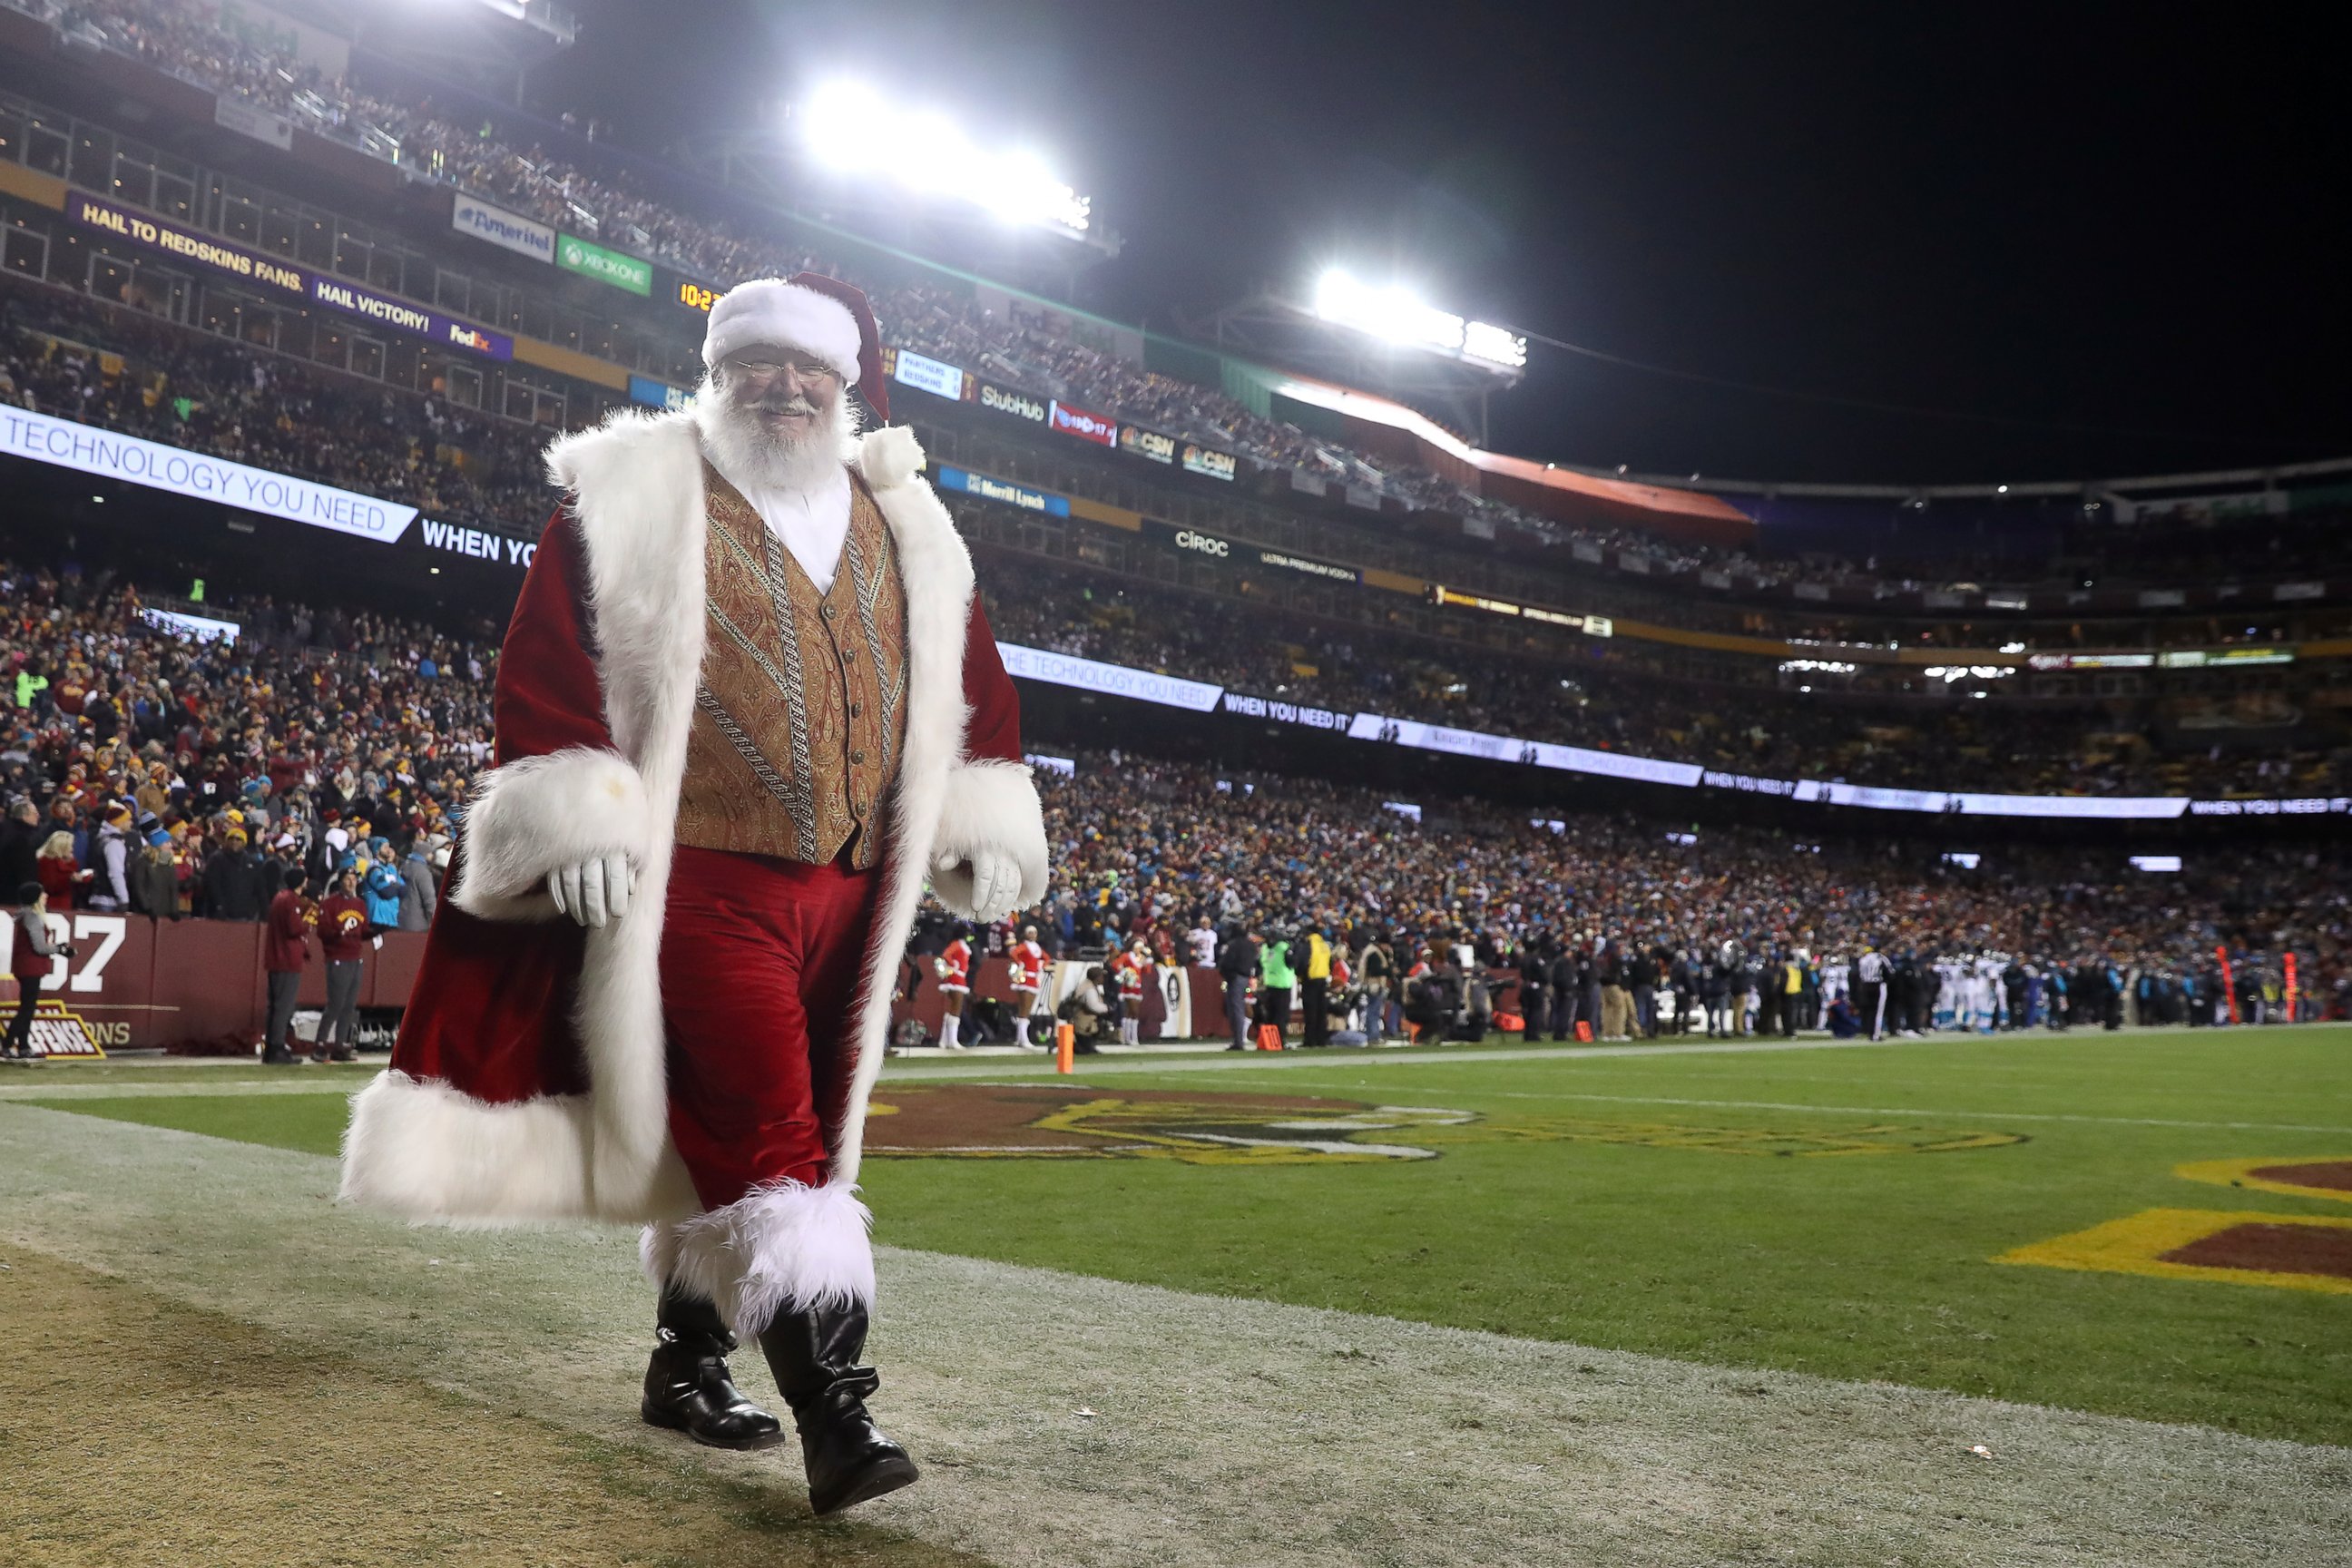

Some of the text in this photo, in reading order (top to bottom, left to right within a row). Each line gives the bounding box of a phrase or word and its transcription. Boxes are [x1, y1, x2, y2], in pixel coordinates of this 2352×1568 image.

[83, 202, 304, 292] HAIL TO REDSKINS FANS.
[318, 281, 429, 333] HAIL VICTORY!
[450, 323, 493, 353] FedEx
[981, 385, 1044, 422] StubHub
[1142, 432, 1175, 456] CSN
[5, 415, 386, 532] TECHNOLOGY YOU NEED
[1203, 450, 1236, 474] CSN
[981, 479, 1044, 510] Merrill Lynch
[421, 518, 538, 568] WHEN YO
[1260, 552, 1356, 582] ULTRA PREMIUM VODKA
[1033, 654, 1135, 691] TECHNOLOGY
[1138, 679, 1169, 699] YOU
[1171, 685, 1209, 706] NEED
[1225, 692, 1267, 718] WHEN
[1268, 701, 1298, 723] YOU
[1298, 706, 1335, 729] NEED
[1704, 770, 1735, 789] WHEN
[1735, 775, 1757, 792] YOU
[1756, 779, 1783, 796] NEED
[2190, 799, 2242, 815] WHEN
[2243, 799, 2279, 815] YOU
[2279, 798, 2329, 814] NEED
